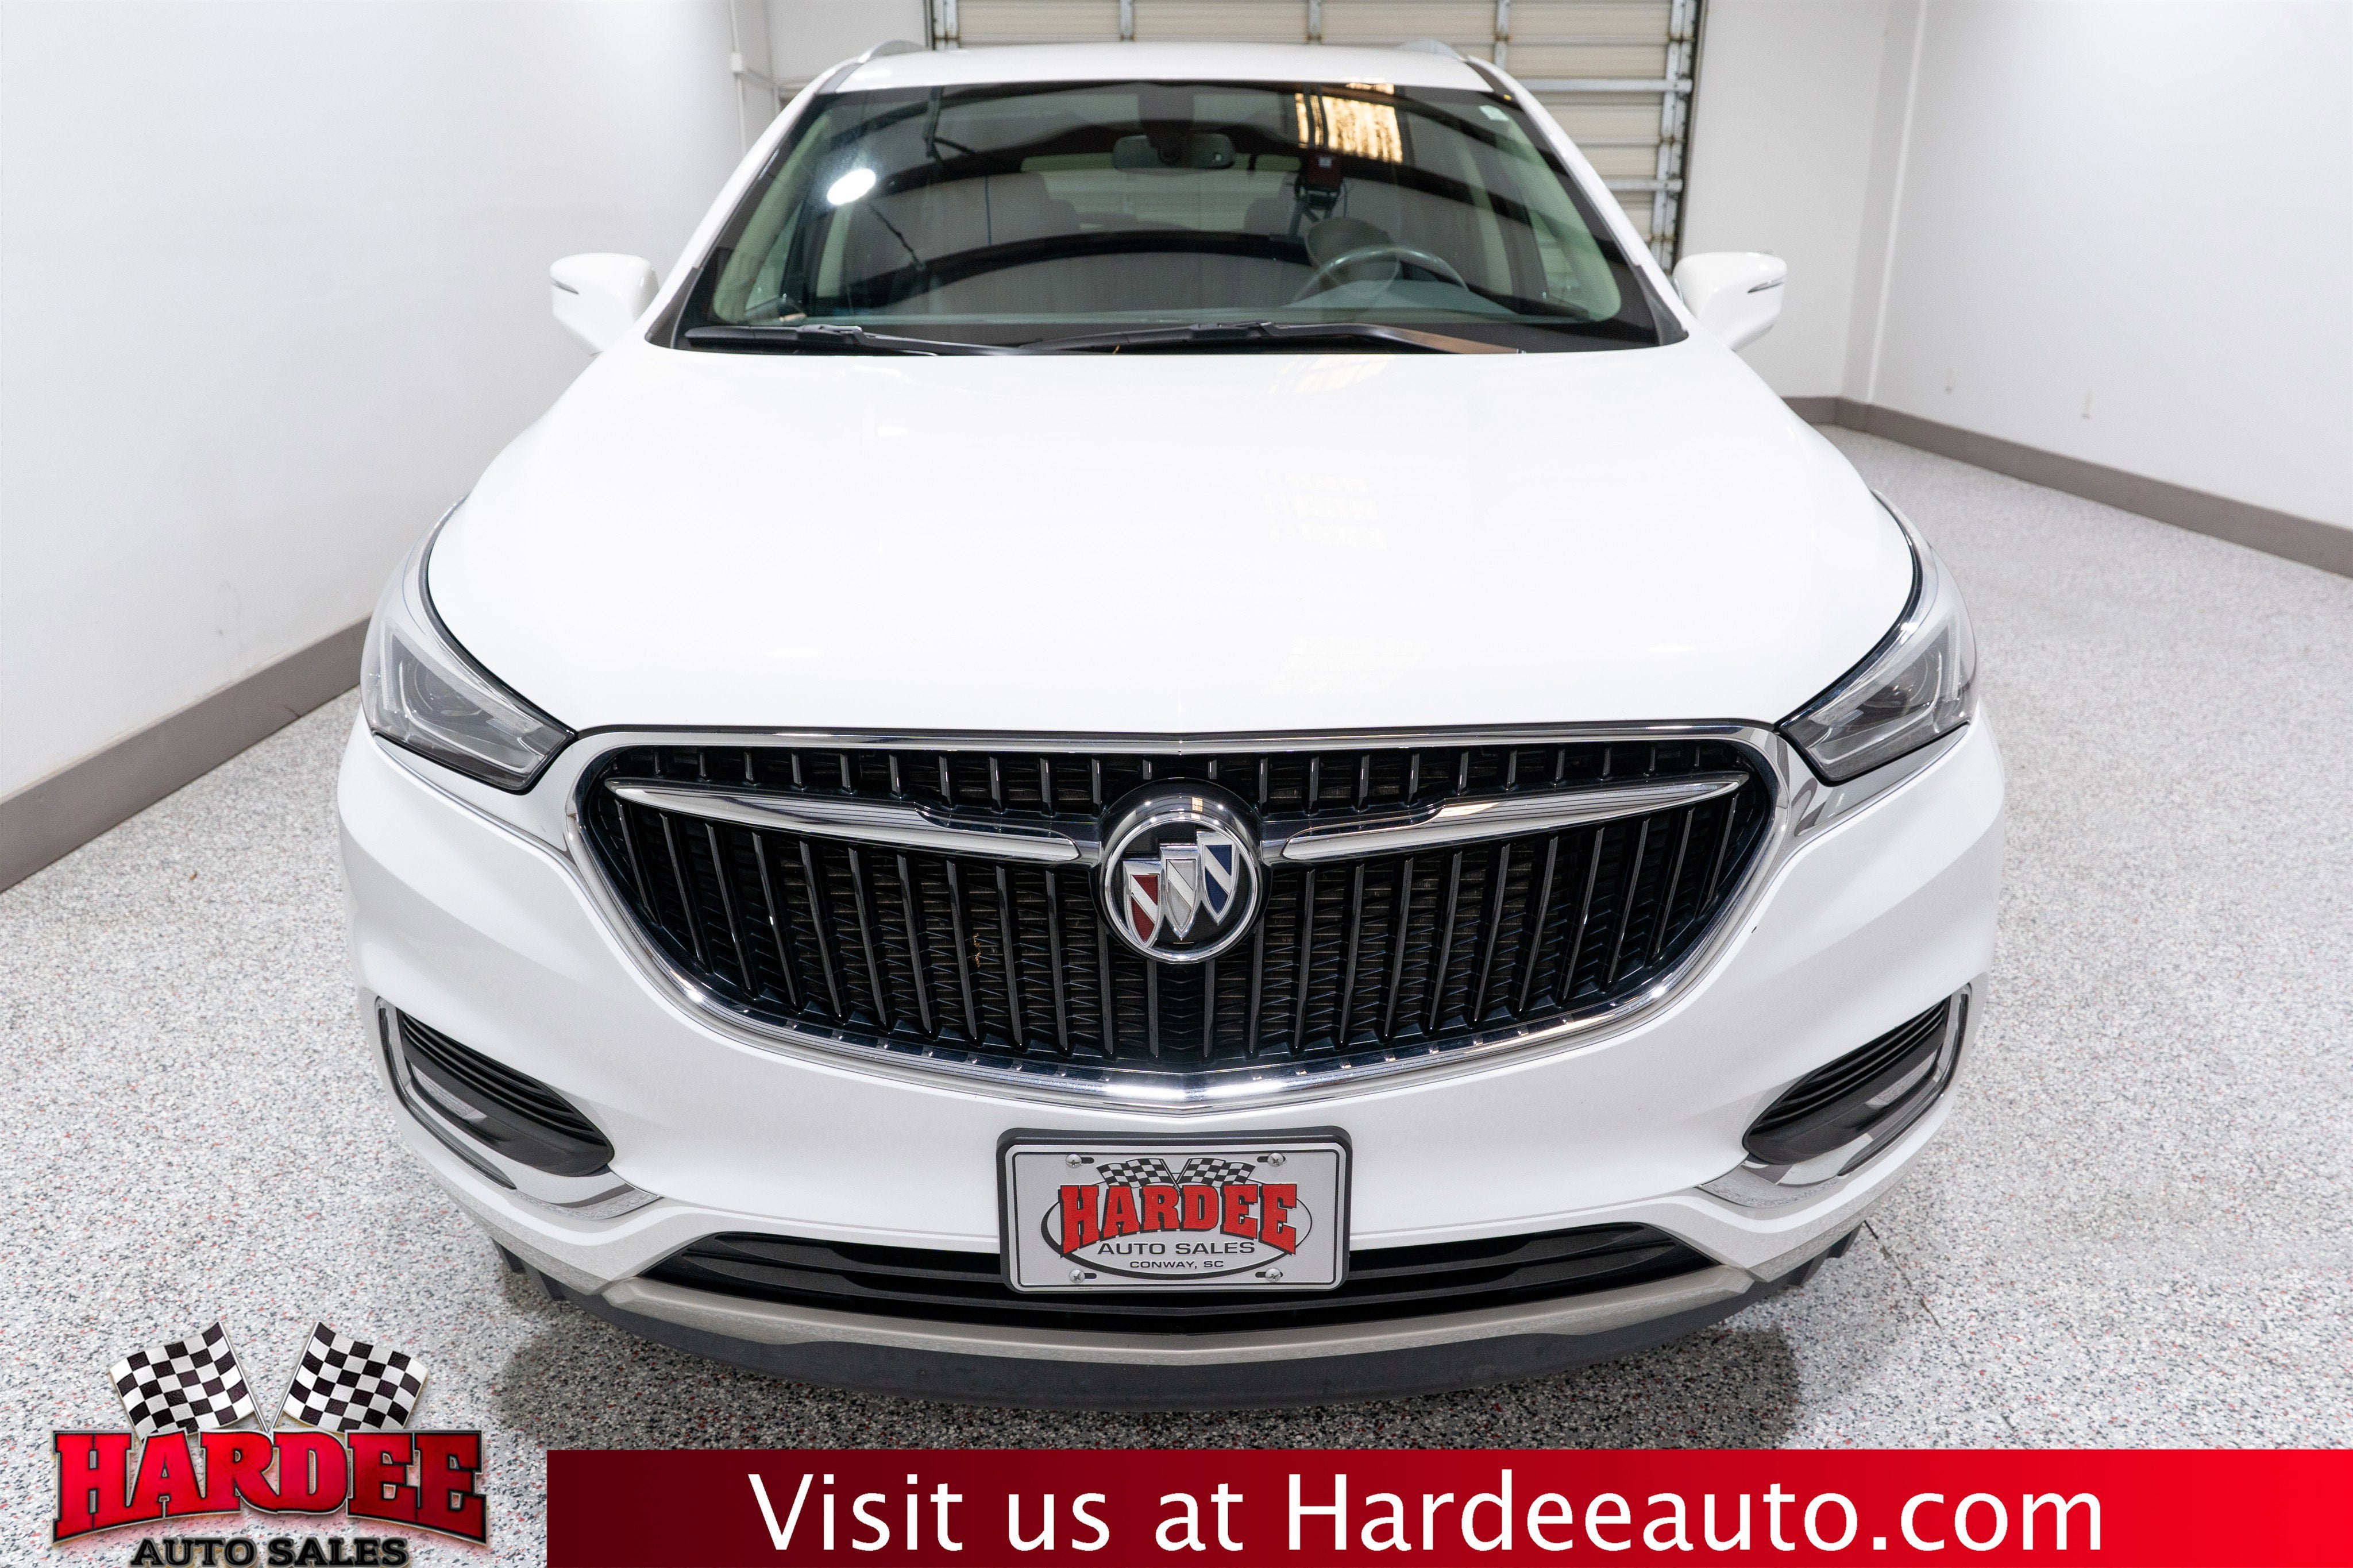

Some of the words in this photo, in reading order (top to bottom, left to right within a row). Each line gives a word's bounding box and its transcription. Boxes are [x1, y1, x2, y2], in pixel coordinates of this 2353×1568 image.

[1058, 1183, 1298, 1258] HARDEE
[1097, 1242, 1166, 1255] AUTO
[1175, 1241, 1255, 1254] SALES
[1129, 1261, 1197, 1269] CONWAY,
